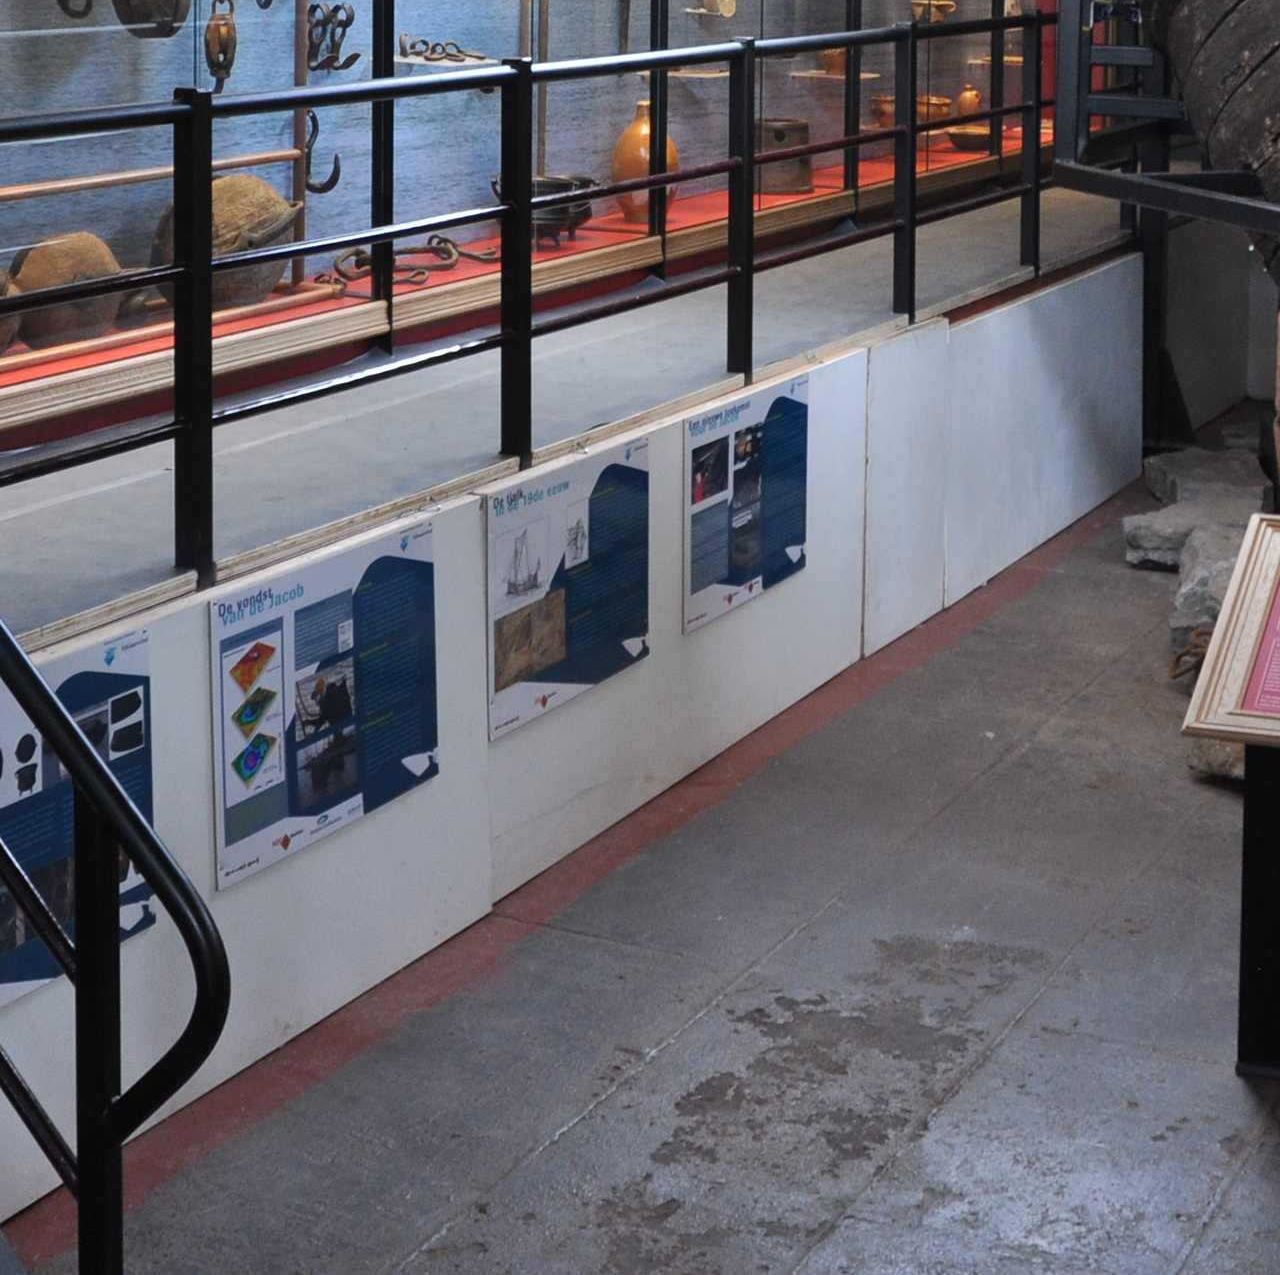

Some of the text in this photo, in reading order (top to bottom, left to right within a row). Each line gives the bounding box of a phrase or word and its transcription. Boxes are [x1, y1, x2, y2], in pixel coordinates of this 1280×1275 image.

[523, 488, 544, 507] 19de
[546, 480, 569, 498] eeuw
[217, 587, 273, 618] De vondst
[222, 583, 305, 627] van de Jacob
